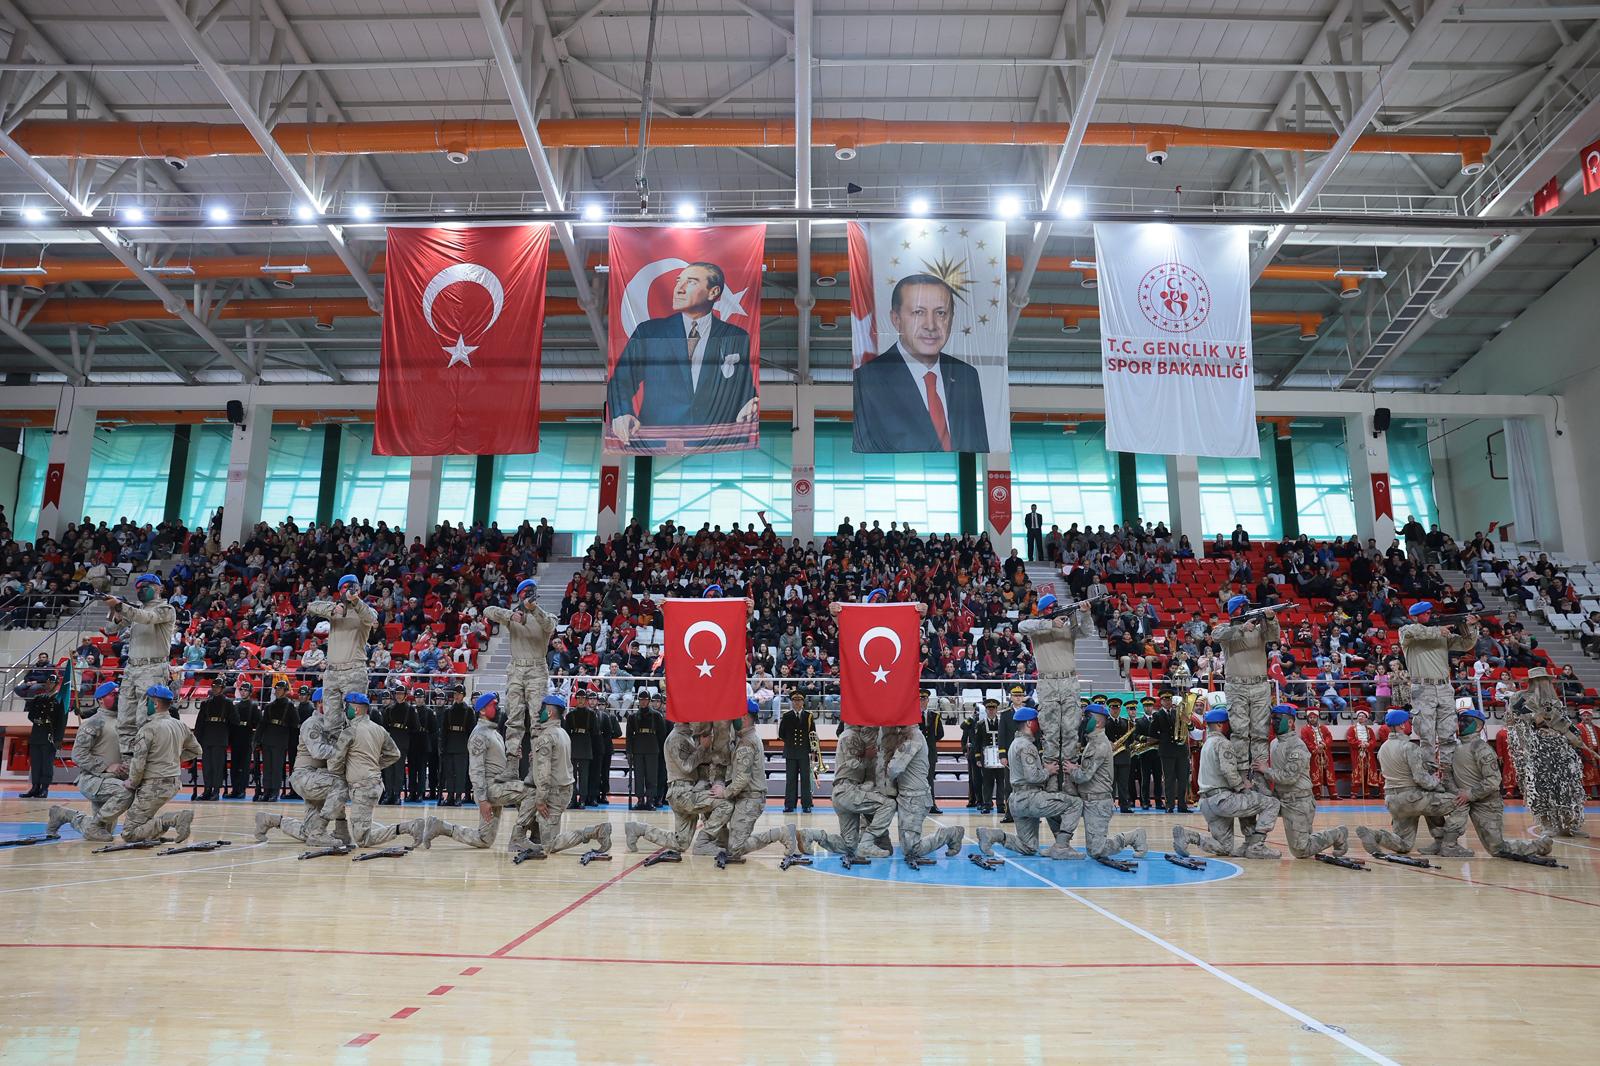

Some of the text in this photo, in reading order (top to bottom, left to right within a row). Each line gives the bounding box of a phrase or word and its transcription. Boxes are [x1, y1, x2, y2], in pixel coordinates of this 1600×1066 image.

[1107, 338, 1247, 359] T.C. GENÇLİK VE
[1108, 358, 1249, 379] SPOR BAKANLIĞI
